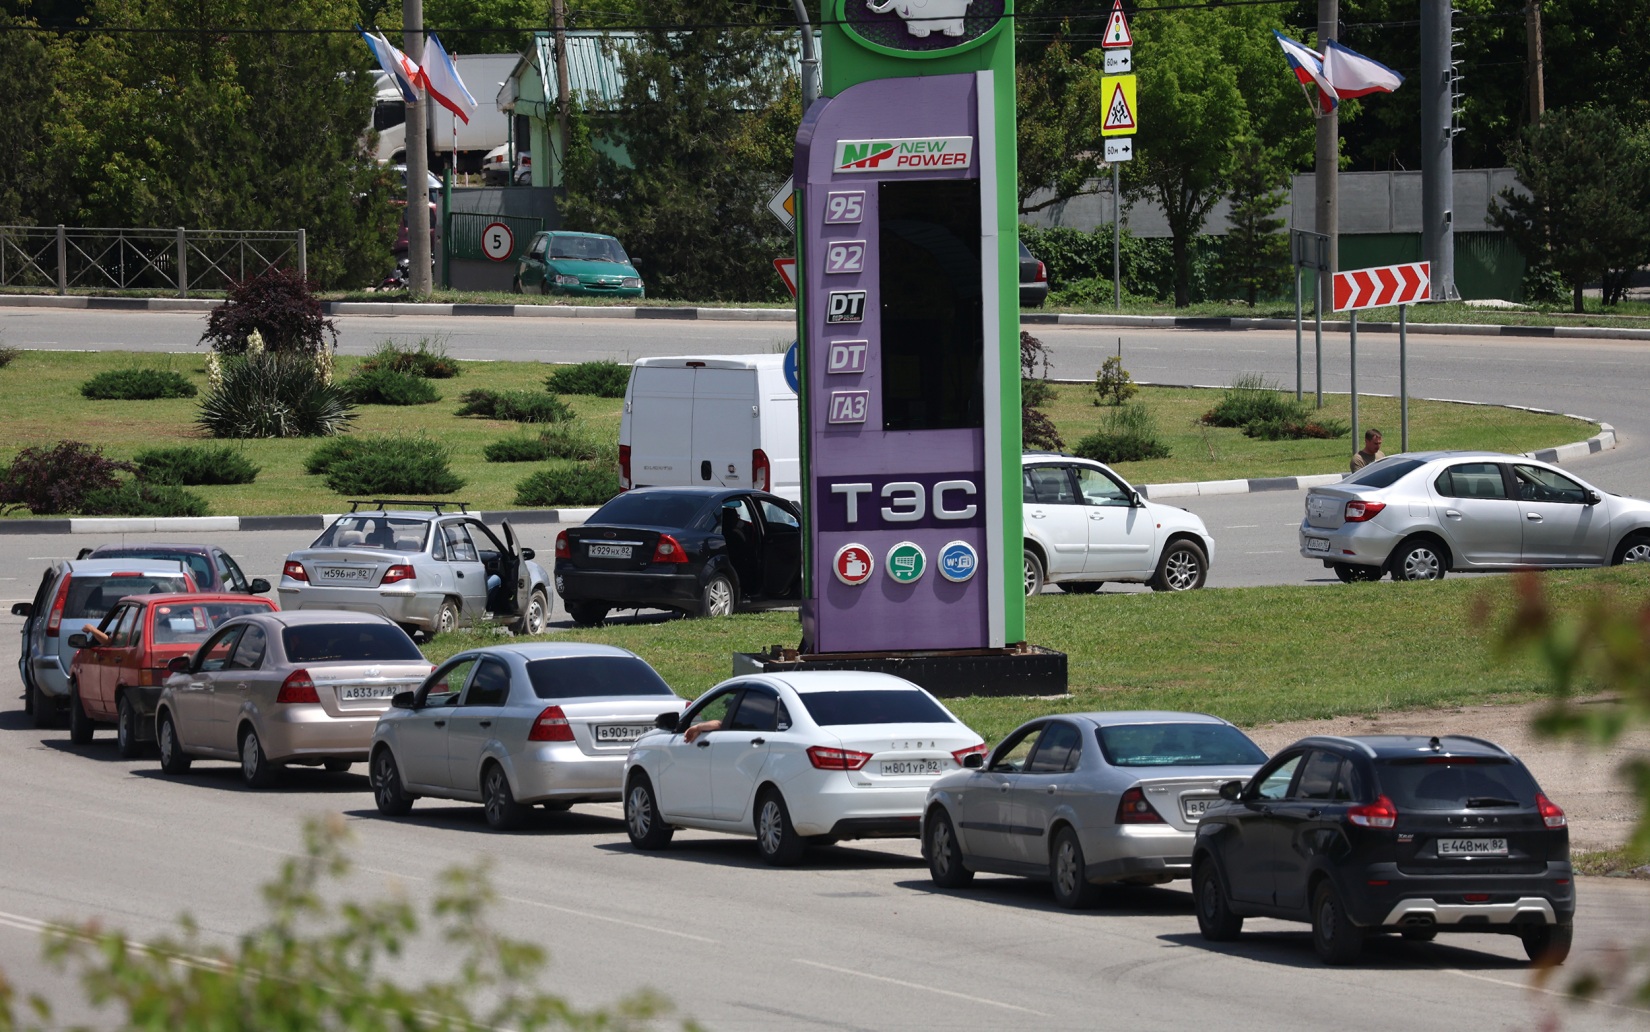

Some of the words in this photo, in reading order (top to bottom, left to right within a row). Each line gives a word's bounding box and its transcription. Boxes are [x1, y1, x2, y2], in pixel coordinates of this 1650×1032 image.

[900, 141, 947, 154] NEW
[897, 153, 967, 167] POWER
[829, 196, 862, 220] 95
[493, 235, 502, 249] 5
[830, 246, 863, 270] 92
[830, 293, 865, 315] DT
[831, 347, 865, 369] DT
[832, 396, 866, 419] ГАЗ
[831, 480, 977, 523] ТЭС
[1447, 816, 1499, 824] LADA
